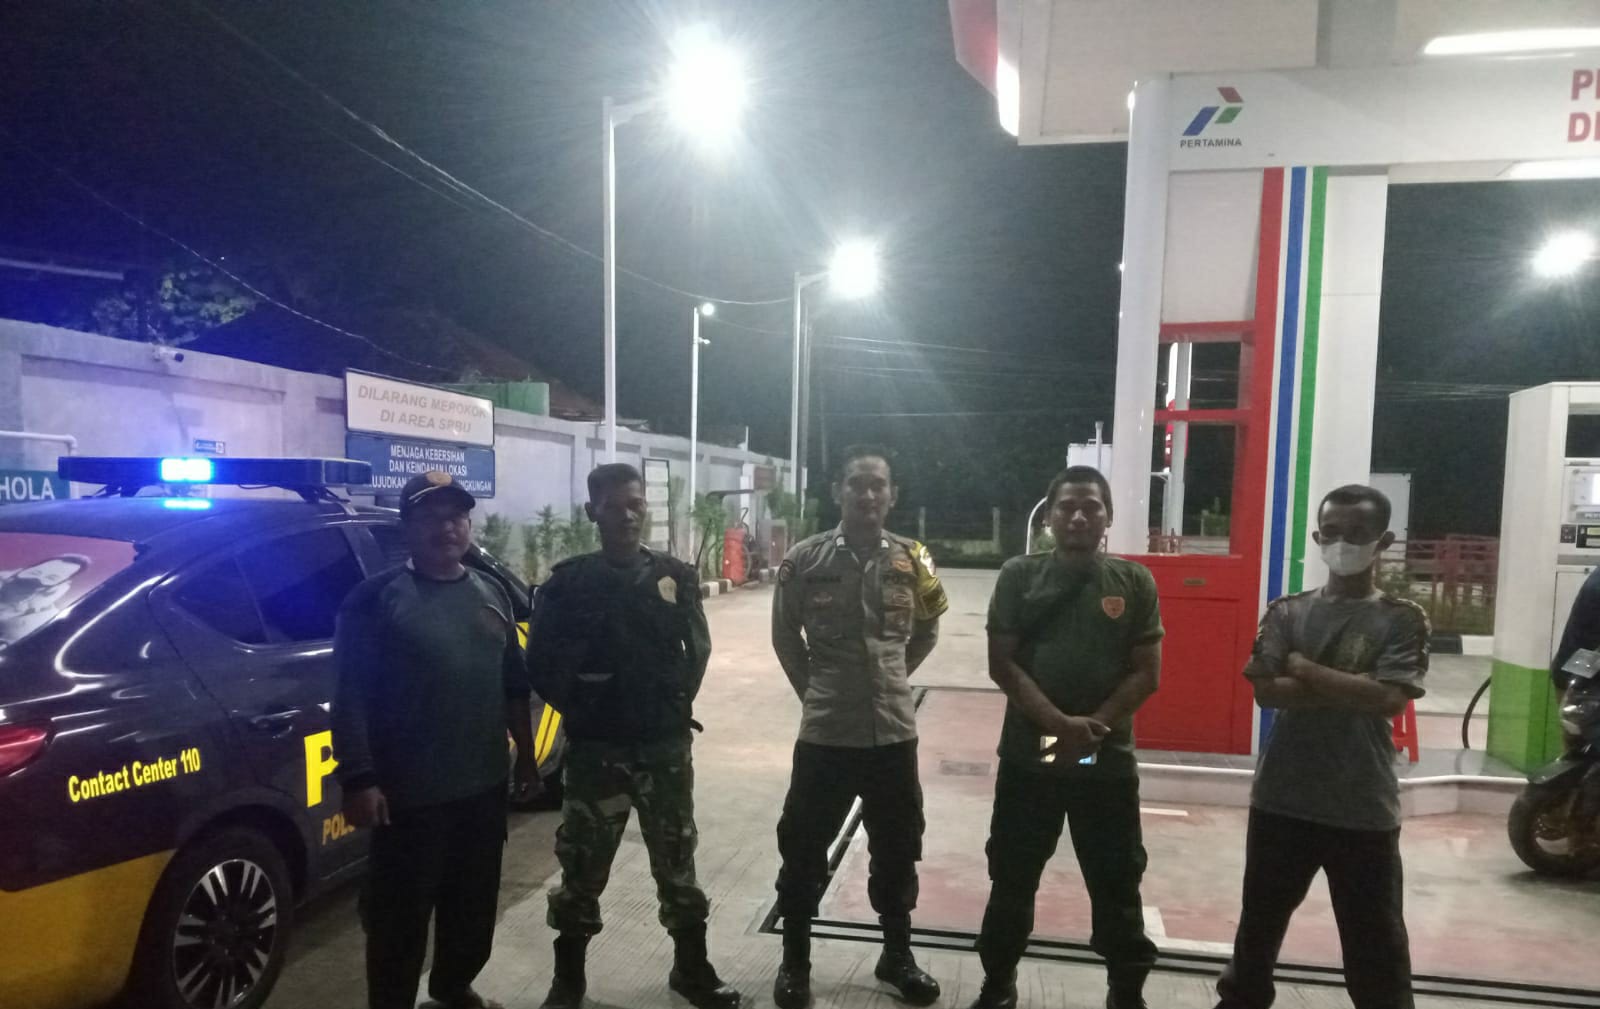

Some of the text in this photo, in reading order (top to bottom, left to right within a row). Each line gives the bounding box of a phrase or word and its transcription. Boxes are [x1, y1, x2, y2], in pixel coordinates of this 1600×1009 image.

[1571, 69, 1600, 100] P
[1180, 138, 1242, 148] PERTAMINA
[358, 385, 427, 408] DILARANG
[380, 409, 394, 423] DI
[398, 413, 435, 429] AREA
[390, 444, 465, 462] MENJAGA KEBERSIHAN
[389, 460, 404, 473] DAN
[362, 474, 407, 489] UJUDKAN
[68, 747, 201, 803] Contact Center 110
